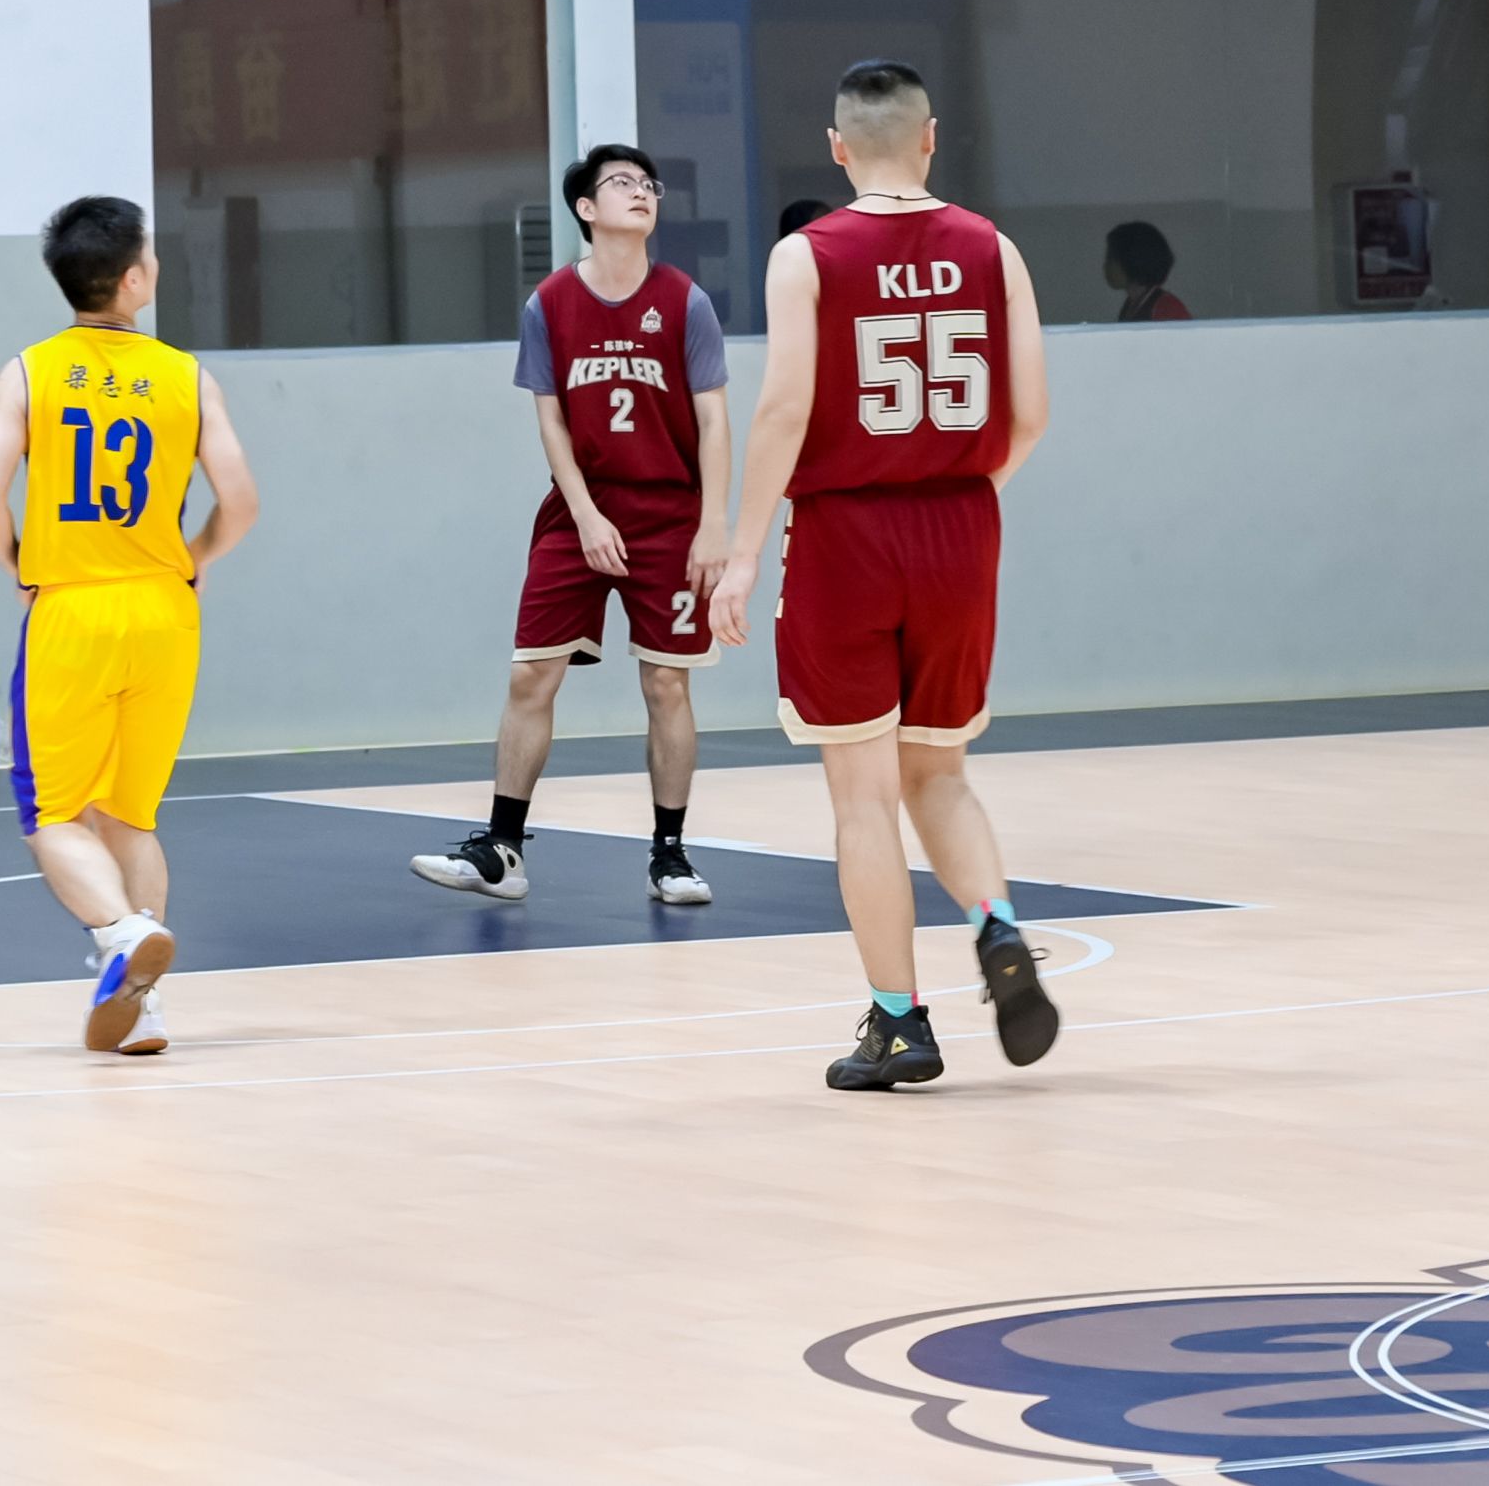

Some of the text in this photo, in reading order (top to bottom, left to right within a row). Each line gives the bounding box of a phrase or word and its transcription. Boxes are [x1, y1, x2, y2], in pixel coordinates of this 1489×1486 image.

[877, 261, 962, 299] KLD
[567, 357, 669, 393] KEPLER
[854, 310, 990, 435] 55
[610, 388, 634, 433] 2
[58, 407, 153, 527] 13
[671, 591, 696, 635] 2
